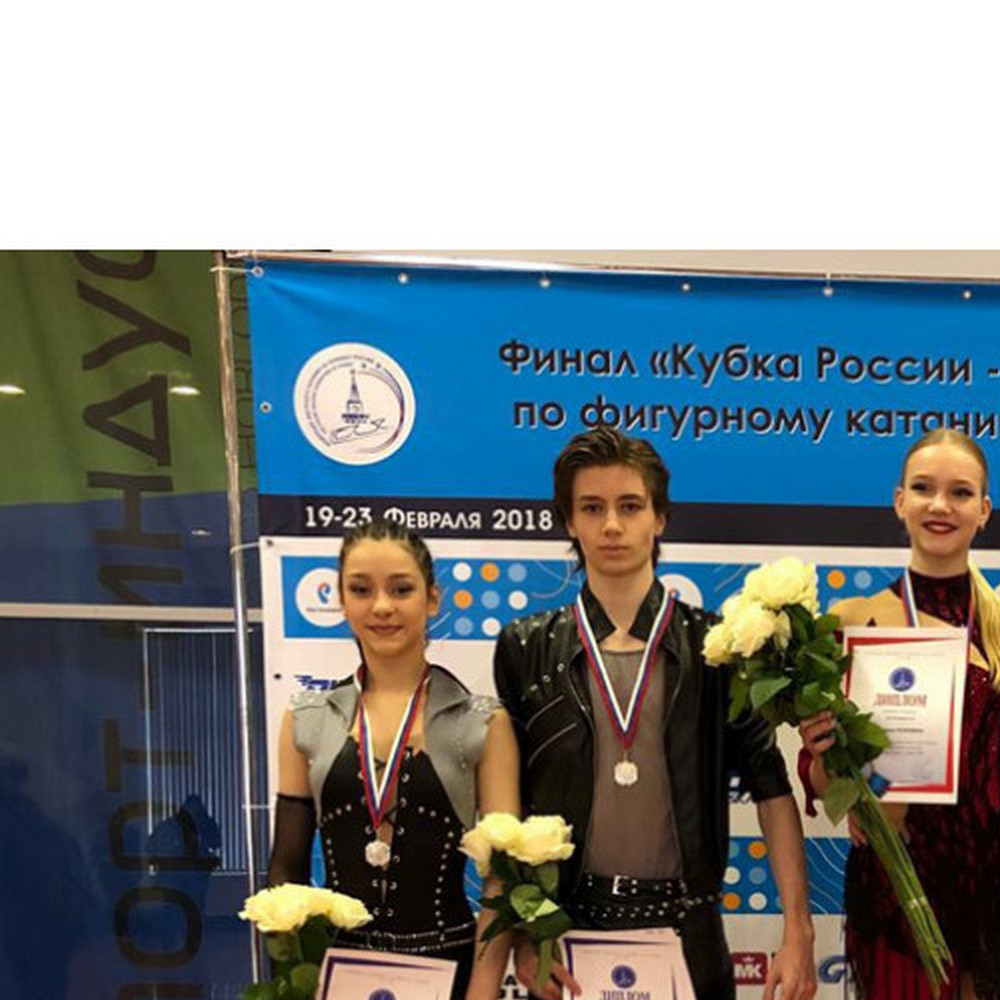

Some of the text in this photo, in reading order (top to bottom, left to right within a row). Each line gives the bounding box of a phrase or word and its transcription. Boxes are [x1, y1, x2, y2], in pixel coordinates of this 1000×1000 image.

[499, 339, 638, 376] Финал
[650, 343, 801, 387] «Кубка
[817, 346, 973, 384] России
[513, 401, 567, 429] по
[580, 394, 833, 443] фигурному
[305, 506, 372, 528] 19-23
[492, 509, 553, 531] 2018
